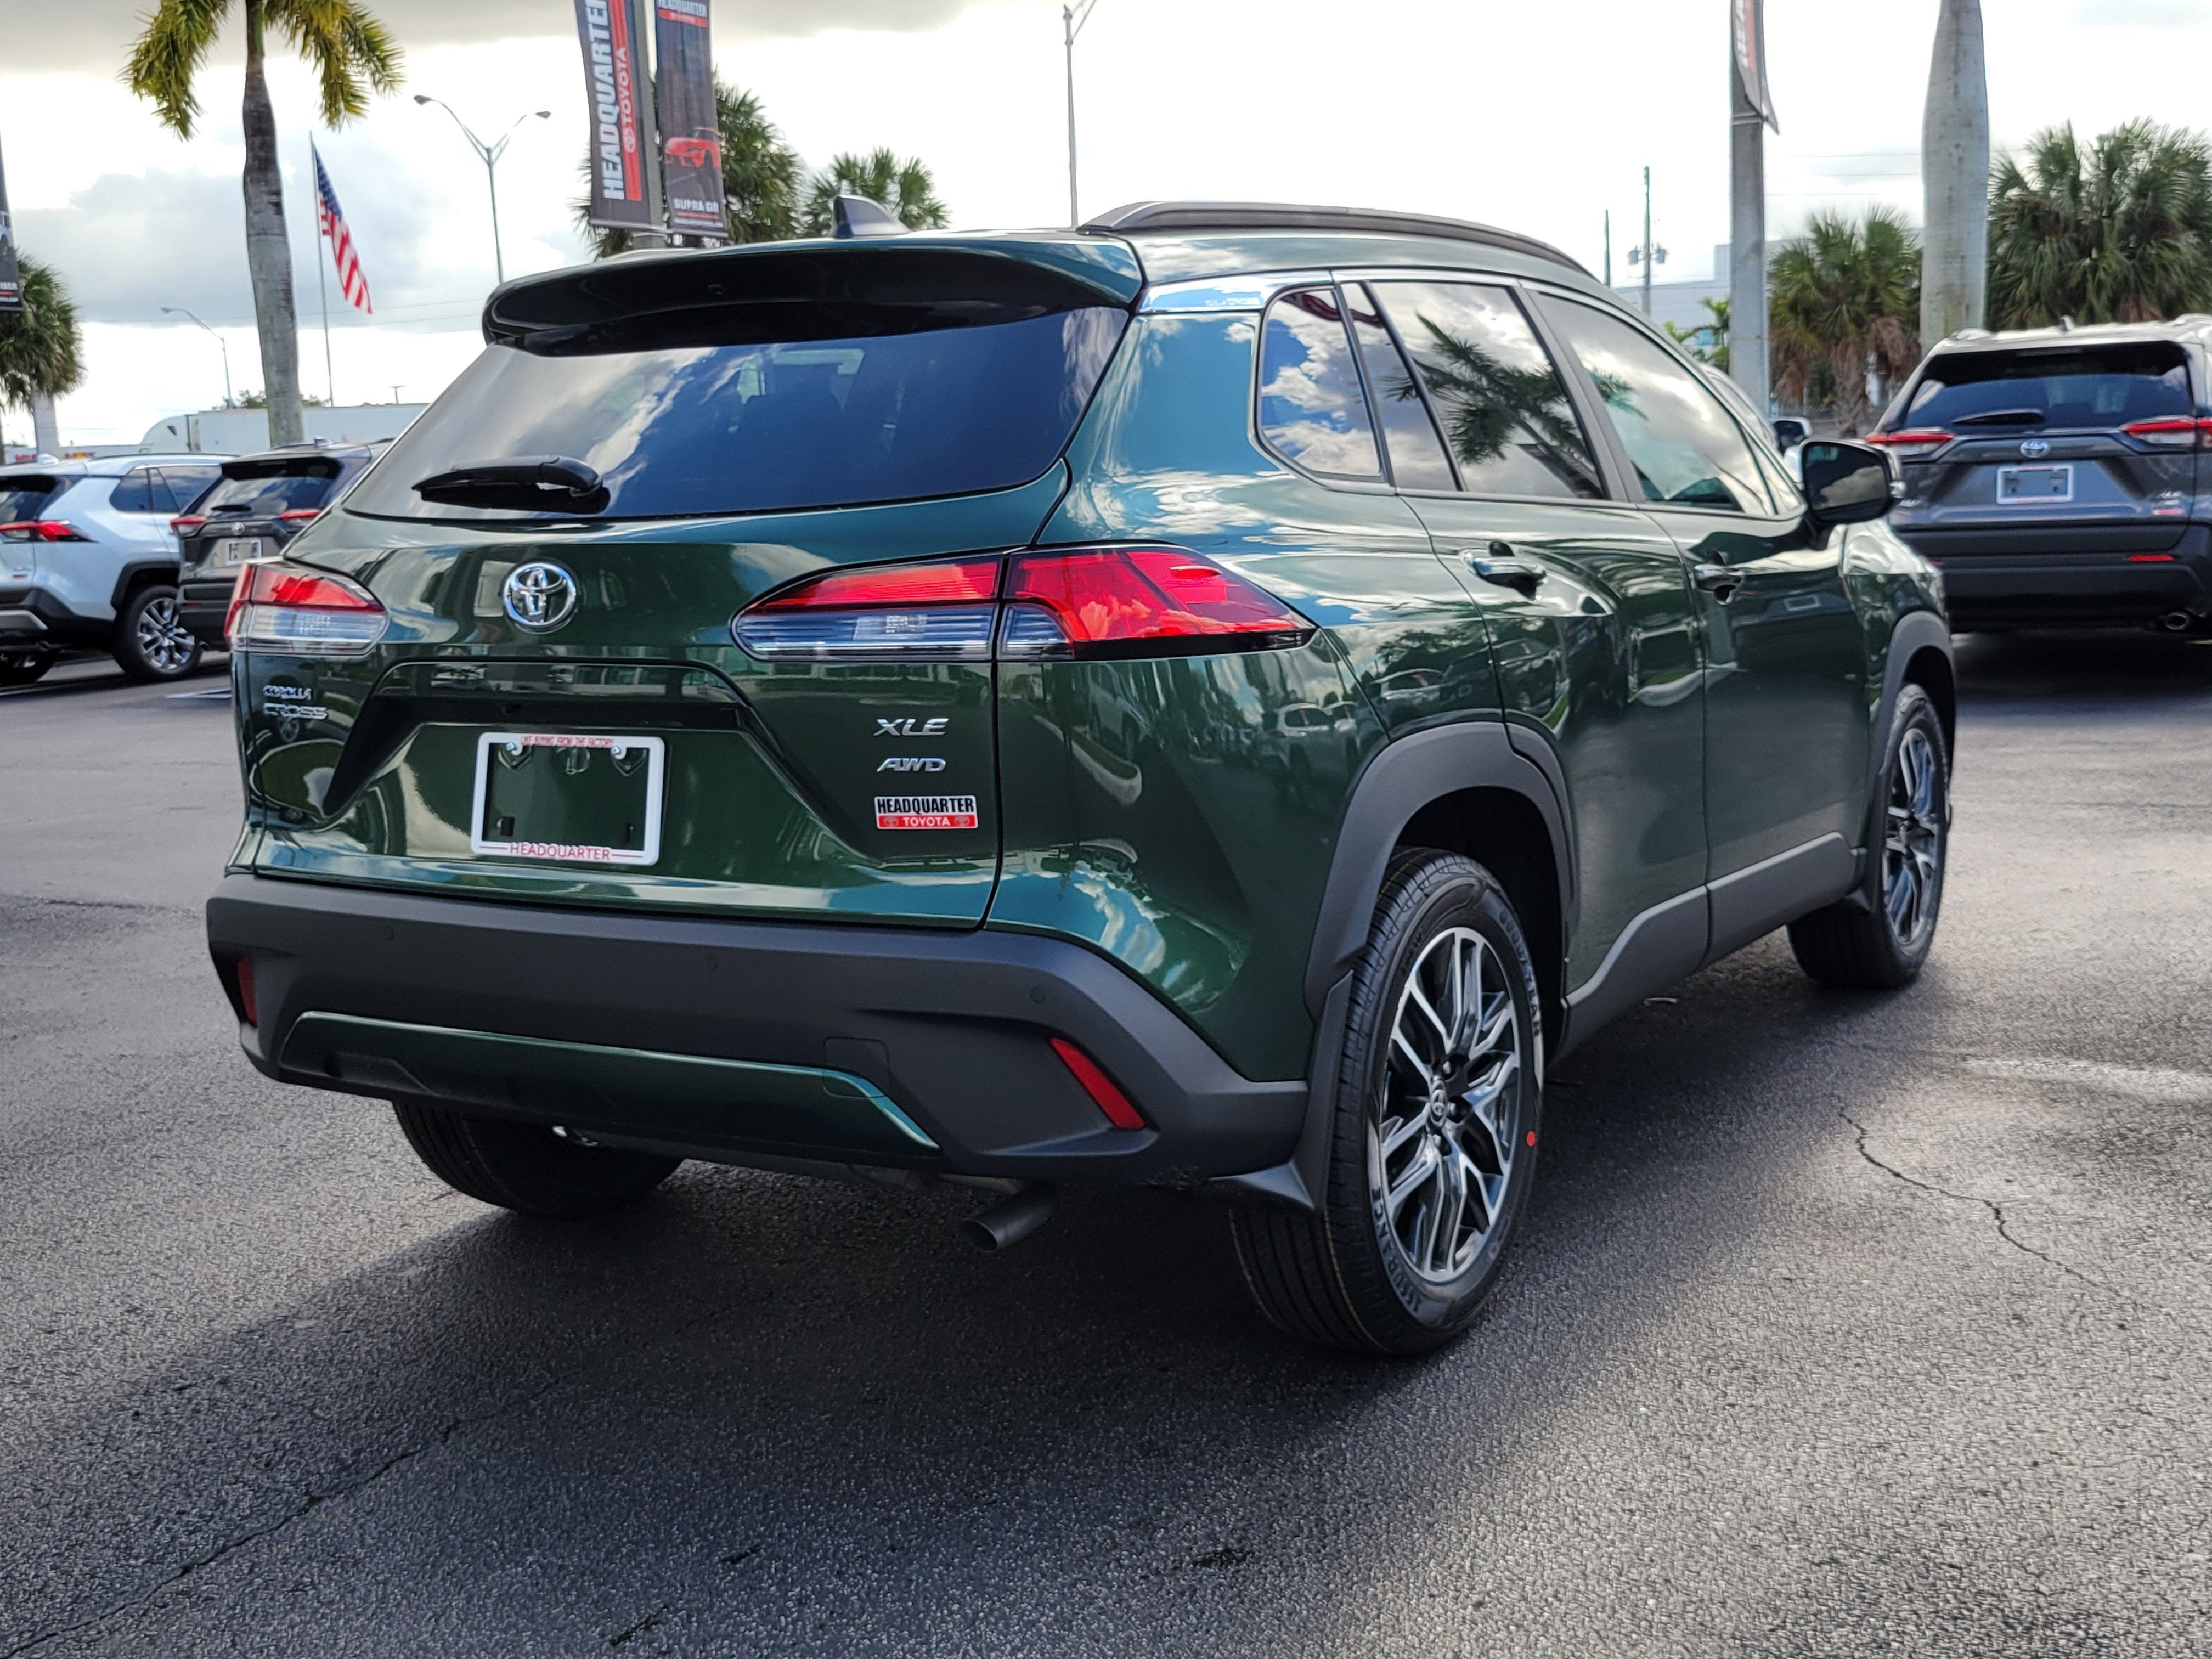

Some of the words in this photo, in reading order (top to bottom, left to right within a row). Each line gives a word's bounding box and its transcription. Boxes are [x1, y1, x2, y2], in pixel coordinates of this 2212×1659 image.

[616, 47, 633, 125] TOYOTA
[263, 702, 328, 720] CROSS
[873, 718, 949, 736] XLE
[877, 757, 946, 772] AWD
[878, 797, 974, 814] HEADQUARTER
[902, 816, 951, 827] TOYOTA
[510, 843, 610, 860] HEADQUARTER
